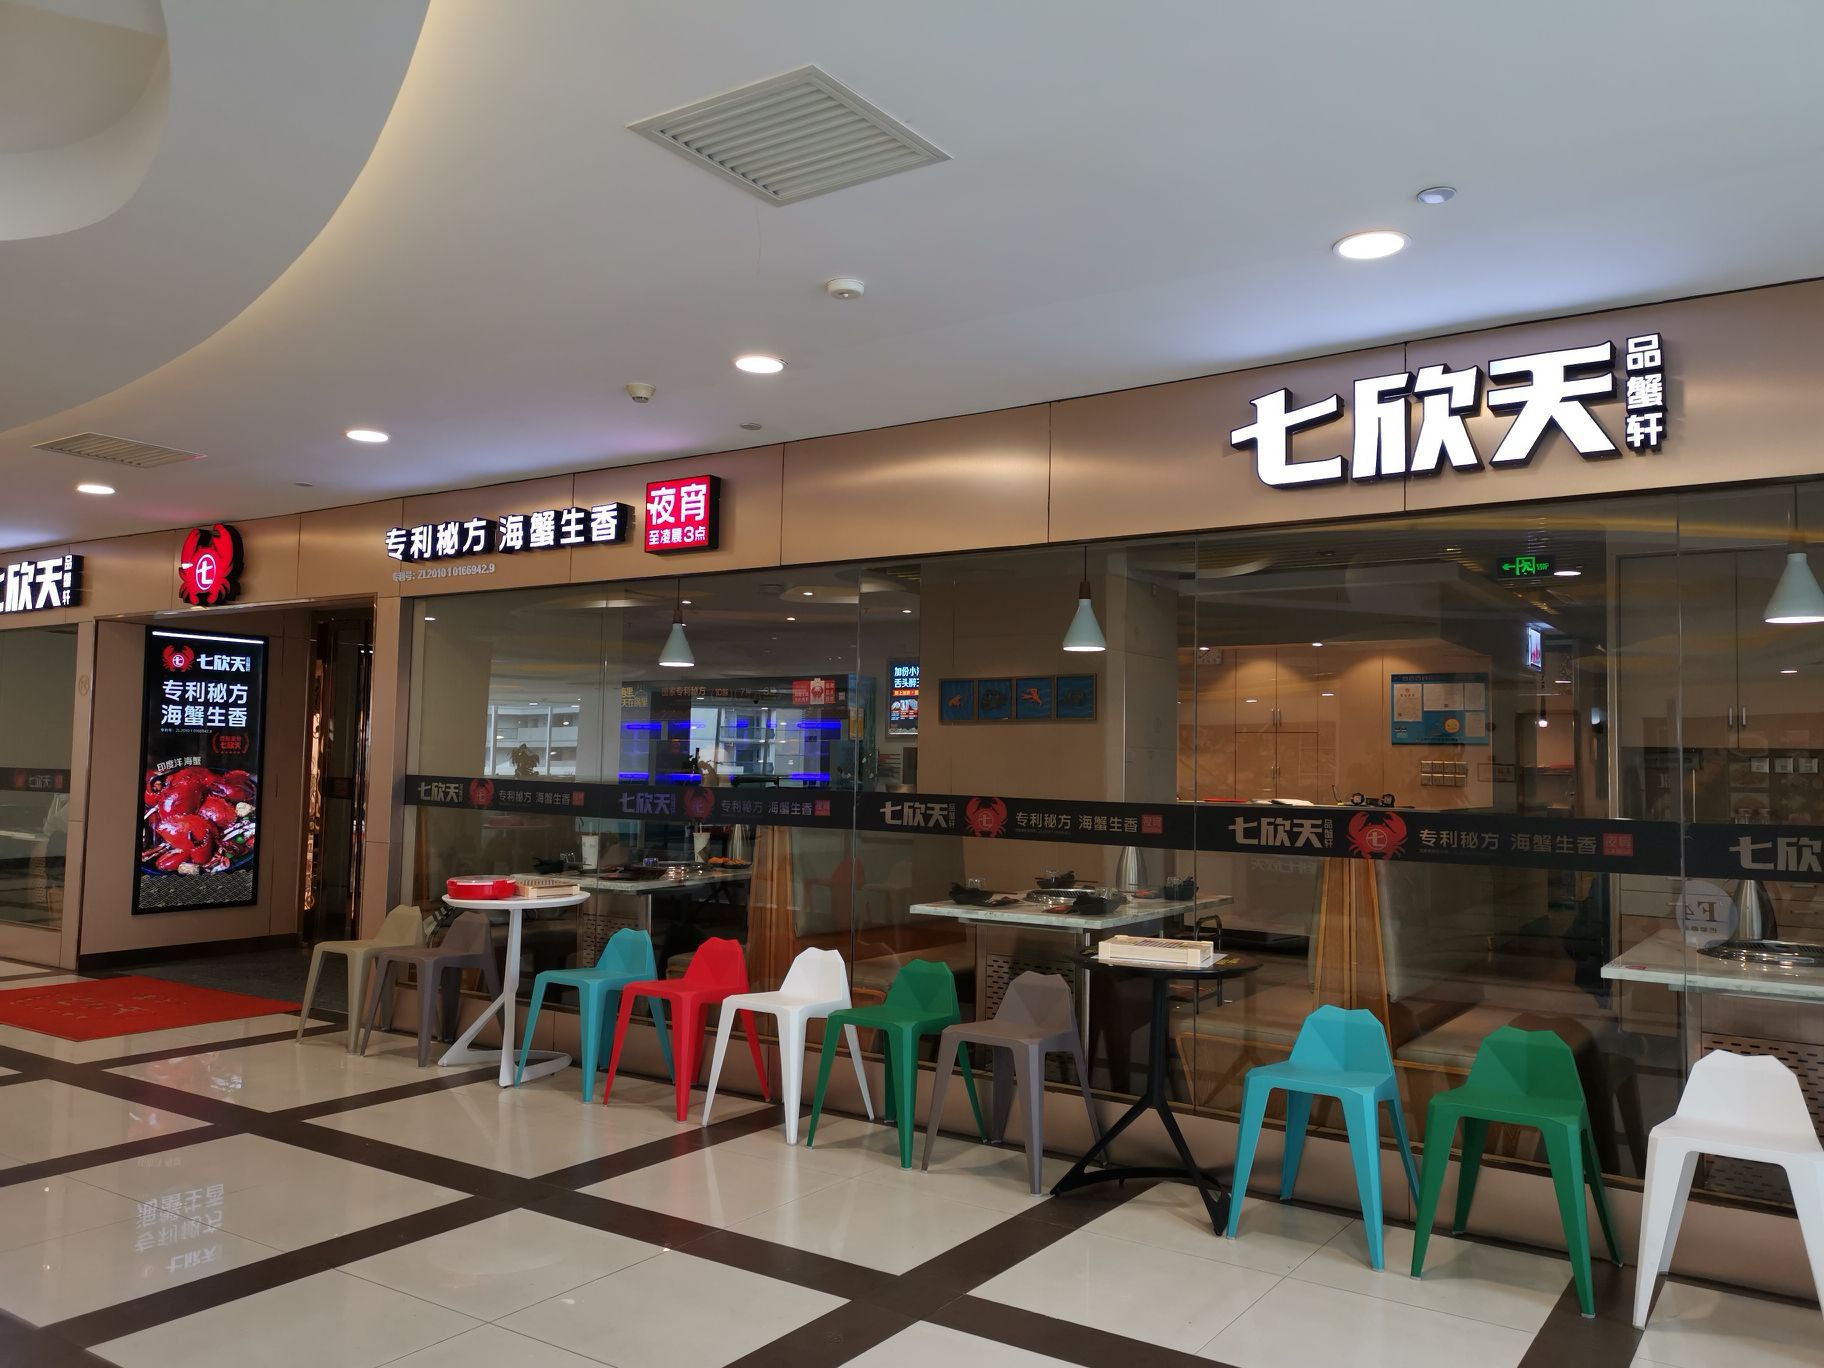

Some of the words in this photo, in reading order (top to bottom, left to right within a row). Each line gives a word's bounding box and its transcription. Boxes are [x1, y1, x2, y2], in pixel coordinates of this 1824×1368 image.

[1626, 333, 1664, 448] 品蟹轩
[1230, 341, 1618, 486] 七欣天
[647, 483, 707, 526] 夜宵
[384, 518, 487, 561] 专利秘方
[498, 503, 618, 552] 海蟹生香
[648, 525, 706, 546] 至凌晨3点
[0, 557, 63, 613] 欣天
[197, 654, 246, 673] 七欣天
[162, 679, 249, 705] 专利秘方
[161, 704, 248, 728] 海蟹生香
[417, 781, 459, 803] 七欣天
[499, 790, 532, 800] 专利秘方
[535, 791, 571, 806] 海蟹生香
[618, 791, 671, 815] 七欣天
[720, 799, 764, 814] 专利秘方
[768, 801, 813, 816] 海蟹生香
[879, 800, 949, 828] 七欣天
[1015, 811, 1072, 830] 专利秘方
[1078, 814, 1139, 833] 海蟹生香
[1228, 816, 1323, 849] 七欣天
[1418, 828, 1499, 850] 专利秘方
[1510, 832, 1597, 855] 海蟹生香
[1729, 835, 1823, 873] 七欣
